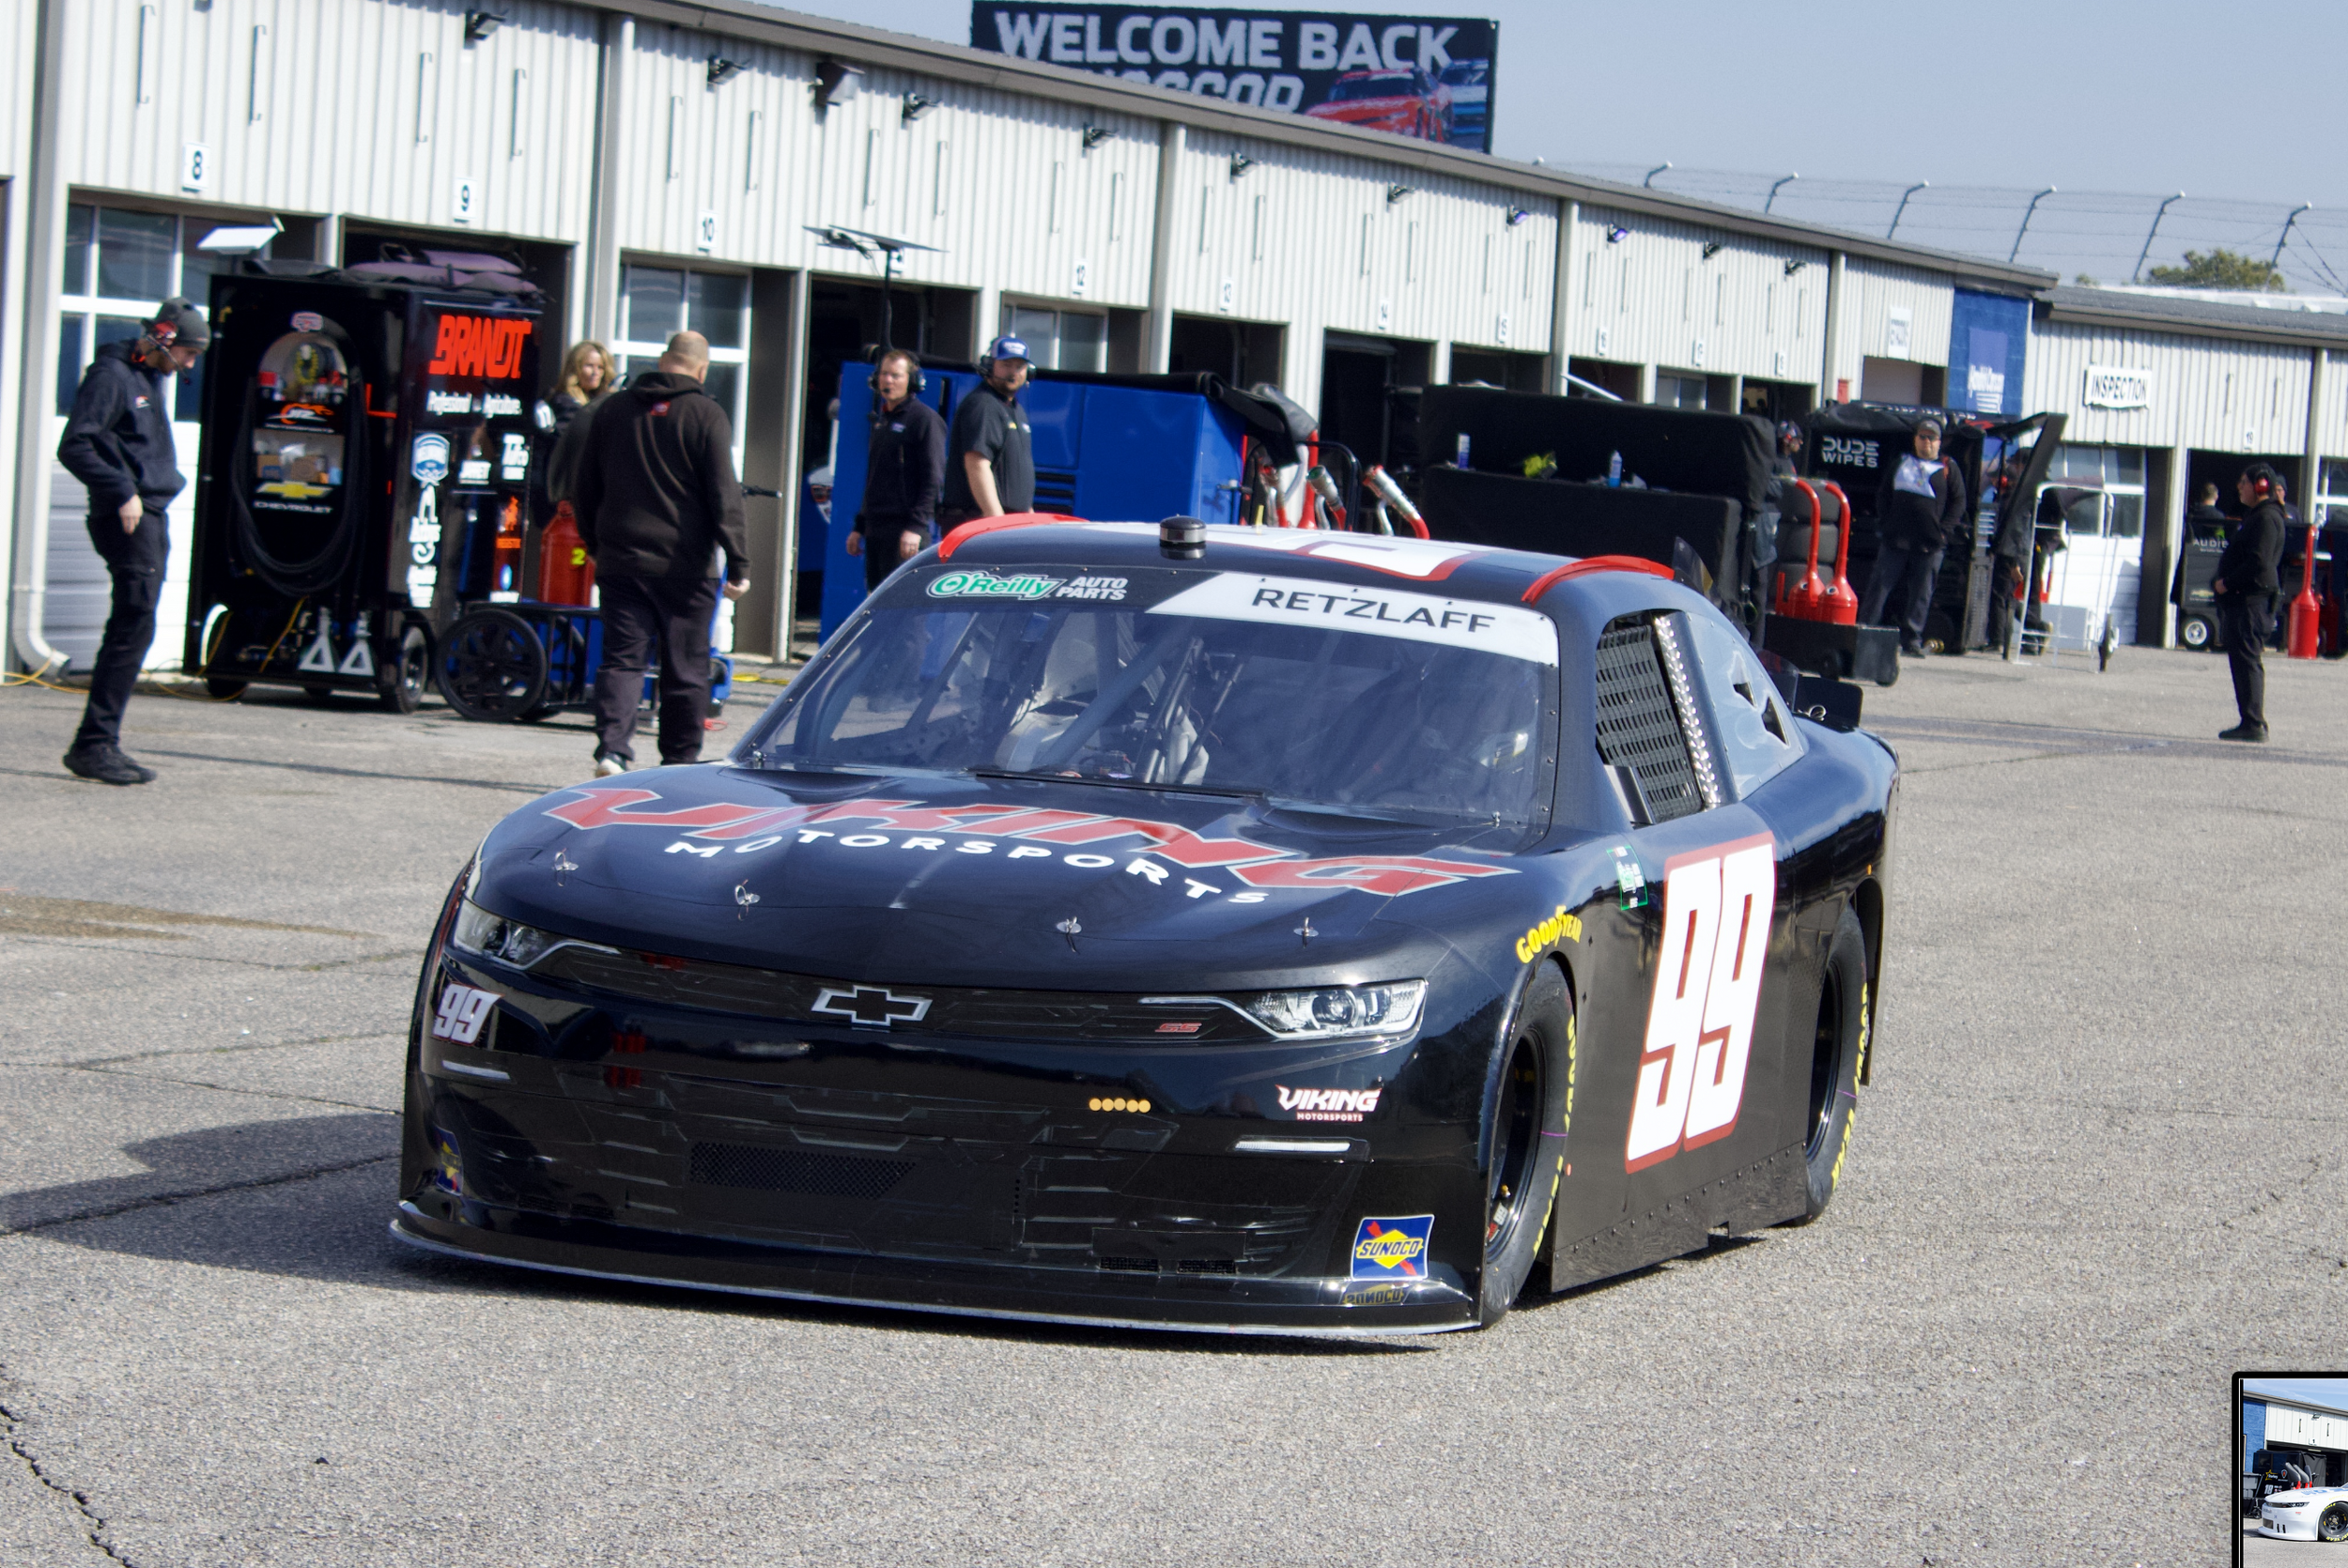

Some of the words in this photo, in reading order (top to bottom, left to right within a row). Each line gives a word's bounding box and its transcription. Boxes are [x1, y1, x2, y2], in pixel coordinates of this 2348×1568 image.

[995, 11, 1284, 69] WELCOME
[1298, 23, 1460, 72] BACK
[193, 149, 203, 181] 8
[461, 184, 471, 212] 9
[703, 216, 715, 242] 10
[1076, 264, 1086, 286] 12
[428, 315, 533, 378] BRANDT
[2092, 374, 2148, 401] INSPECTION
[1821, 450, 1878, 469] WIPES
[1822, 435, 1878, 457] DUDE
[933, 571, 1063, 599] O'Reilly
[1070, 576, 1128, 589] AUTO
[1056, 586, 1127, 600] PARTS
[1253, 587, 1497, 634] RETZLAFF
[542, 789, 1523, 897] VIKING
[664, 829, 1270, 904] MOTORSPORTS
[1516, 905, 1583, 963] GOODYEAR
[433, 983, 503, 1045] 99
[1625, 830, 1777, 1174] 99
[1154, 1022, 1202, 1033] SS
[1275, 1084, 1383, 1112] VIKING
[1296, 1112, 1364, 1122] MOTORSPORTS
[1358, 1240, 1421, 1256] SUNOCO
